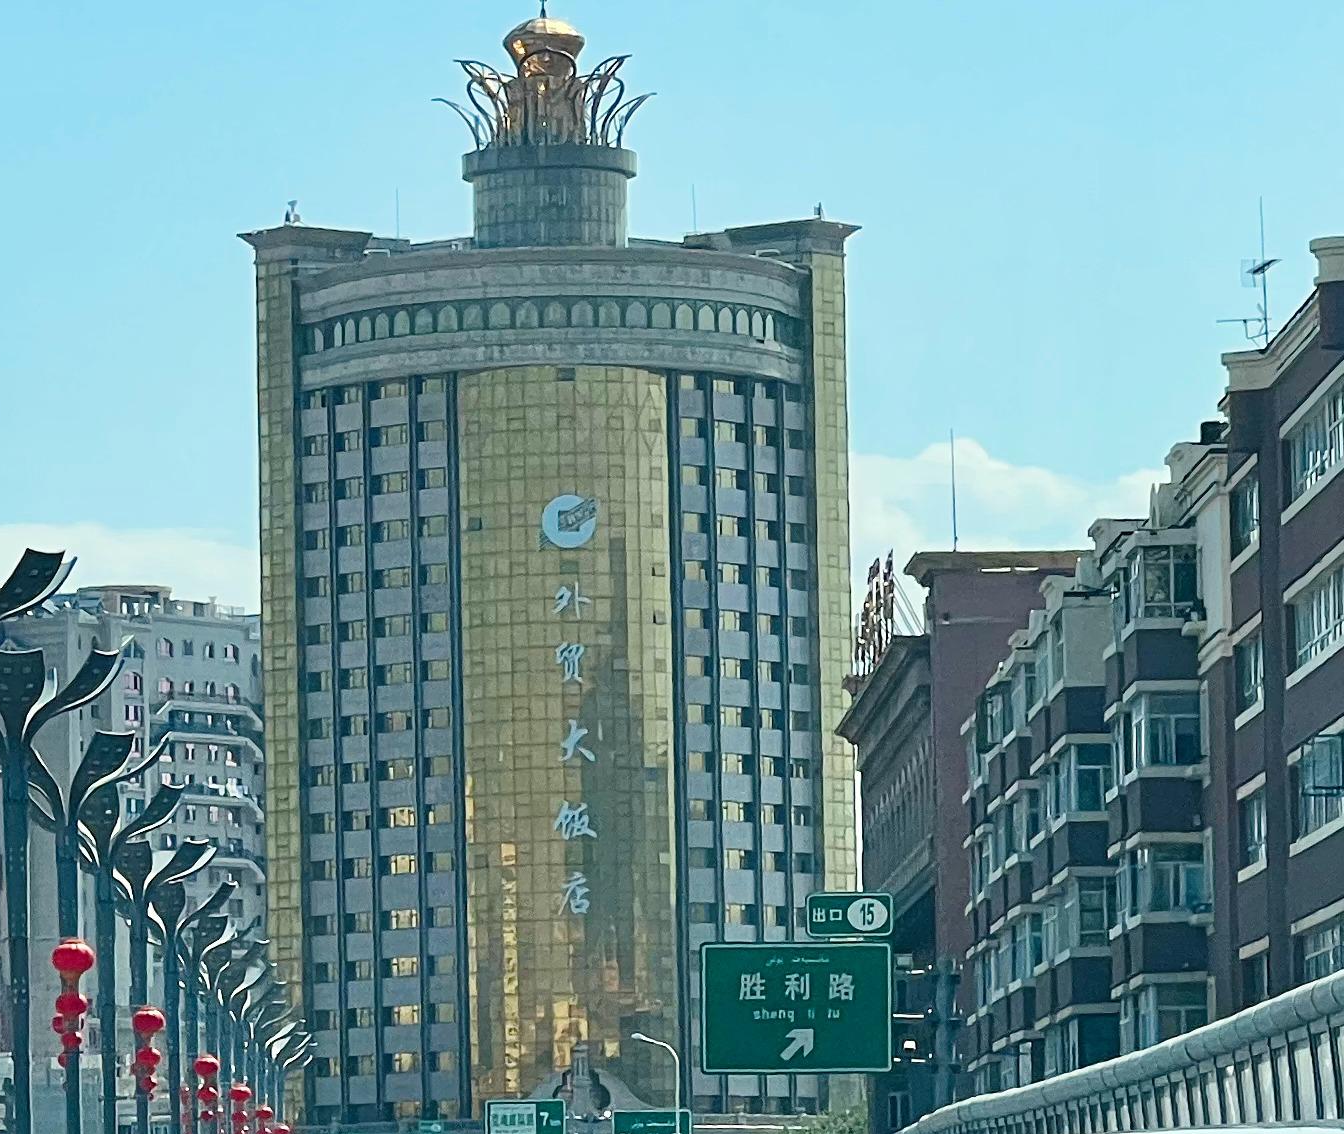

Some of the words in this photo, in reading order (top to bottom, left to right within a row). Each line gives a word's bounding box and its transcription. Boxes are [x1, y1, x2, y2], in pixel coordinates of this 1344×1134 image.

[552, 581, 598, 915] 外贸大饭店
[812, 907, 843, 922] 出口
[859, 903, 875, 926] 15
[739, 972, 855, 1001] 胜利路
